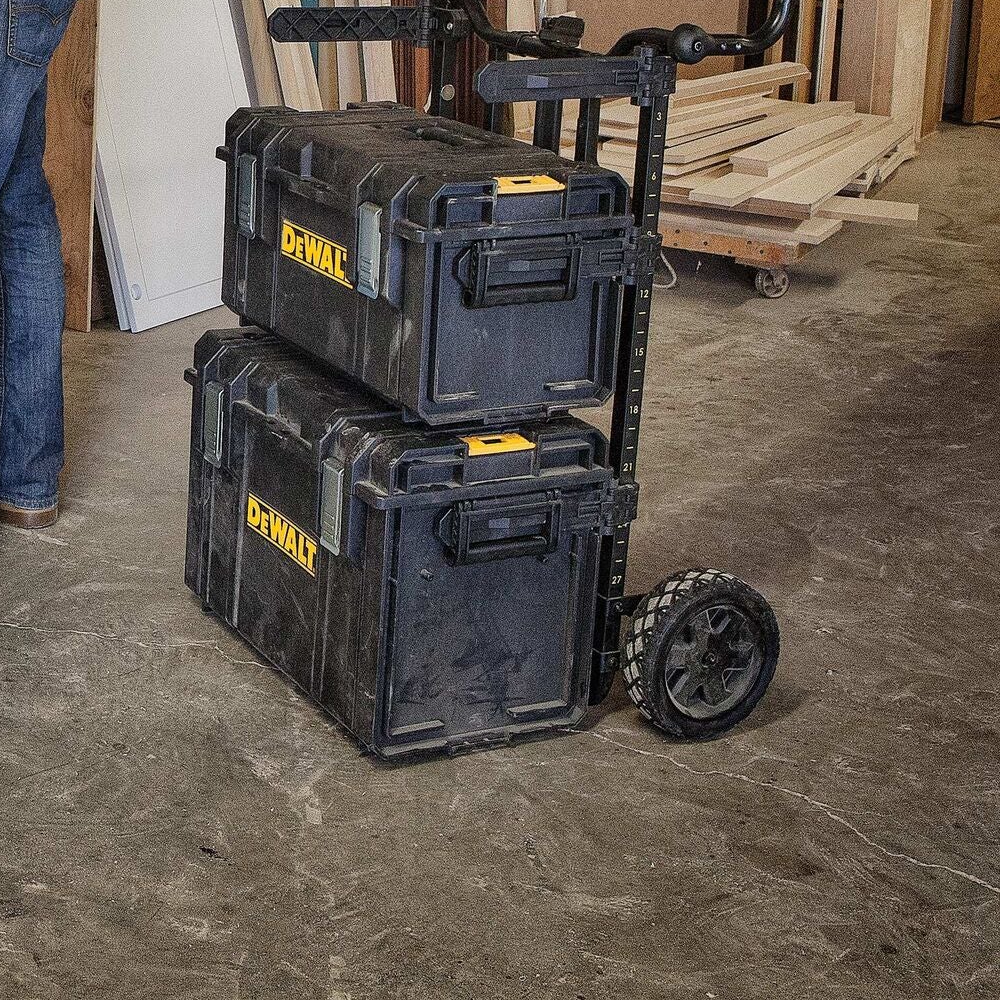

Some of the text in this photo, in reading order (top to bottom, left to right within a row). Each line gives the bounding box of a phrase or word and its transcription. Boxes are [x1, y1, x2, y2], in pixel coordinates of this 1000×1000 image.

[656, 112, 662, 121] 3
[651, 172, 657, 181] 6
[639, 289, 649, 299] 12
[634, 347, 644, 357] 15
[629, 405, 639, 415] 18
[622, 462, 633, 472] 21
[247, 496, 317, 572] DEWALT
[611, 575, 622, 585] 27
